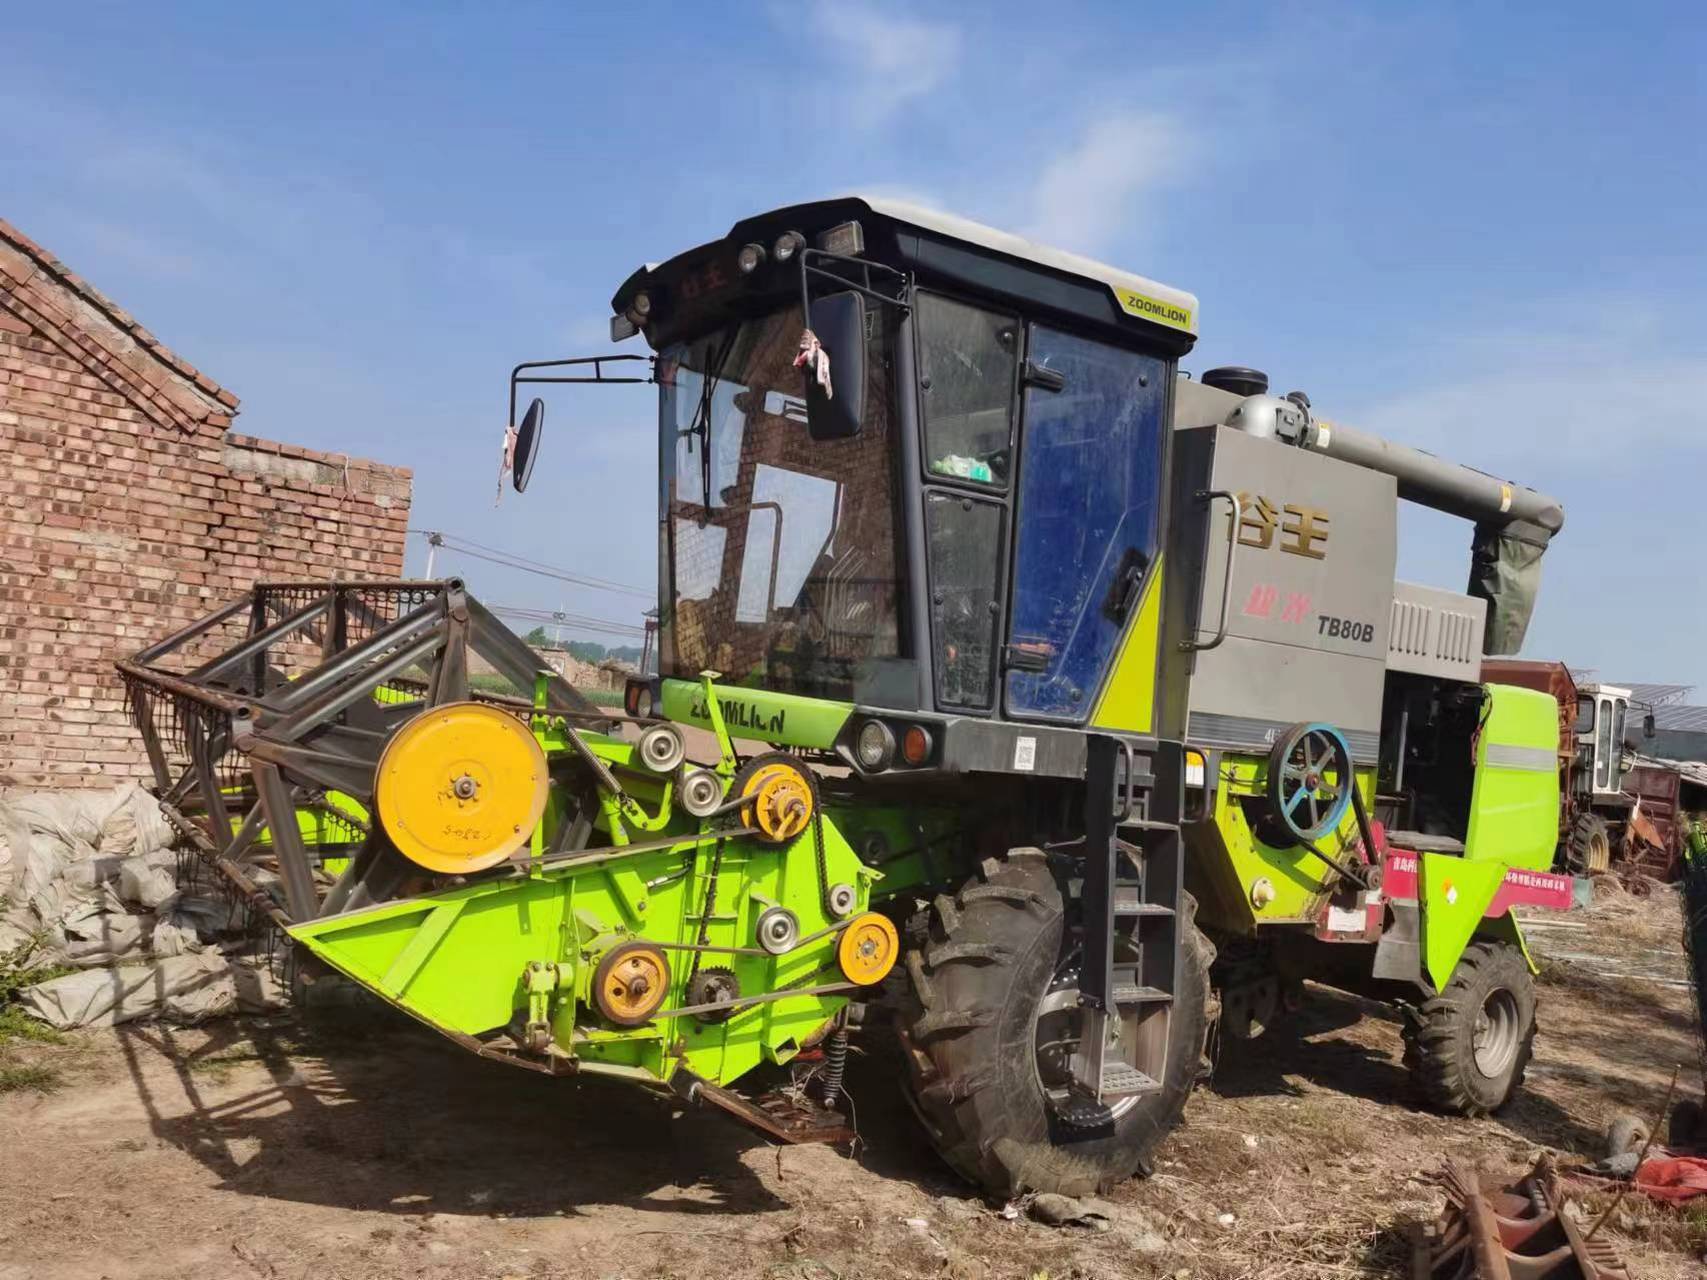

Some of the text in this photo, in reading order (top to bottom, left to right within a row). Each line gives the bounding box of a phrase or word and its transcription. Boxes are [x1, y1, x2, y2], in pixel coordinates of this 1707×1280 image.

[1128, 296, 1187, 324] ZOOMLION
[1225, 491, 1329, 560] 谷王
[1317, 615, 1374, 643] TB80B
